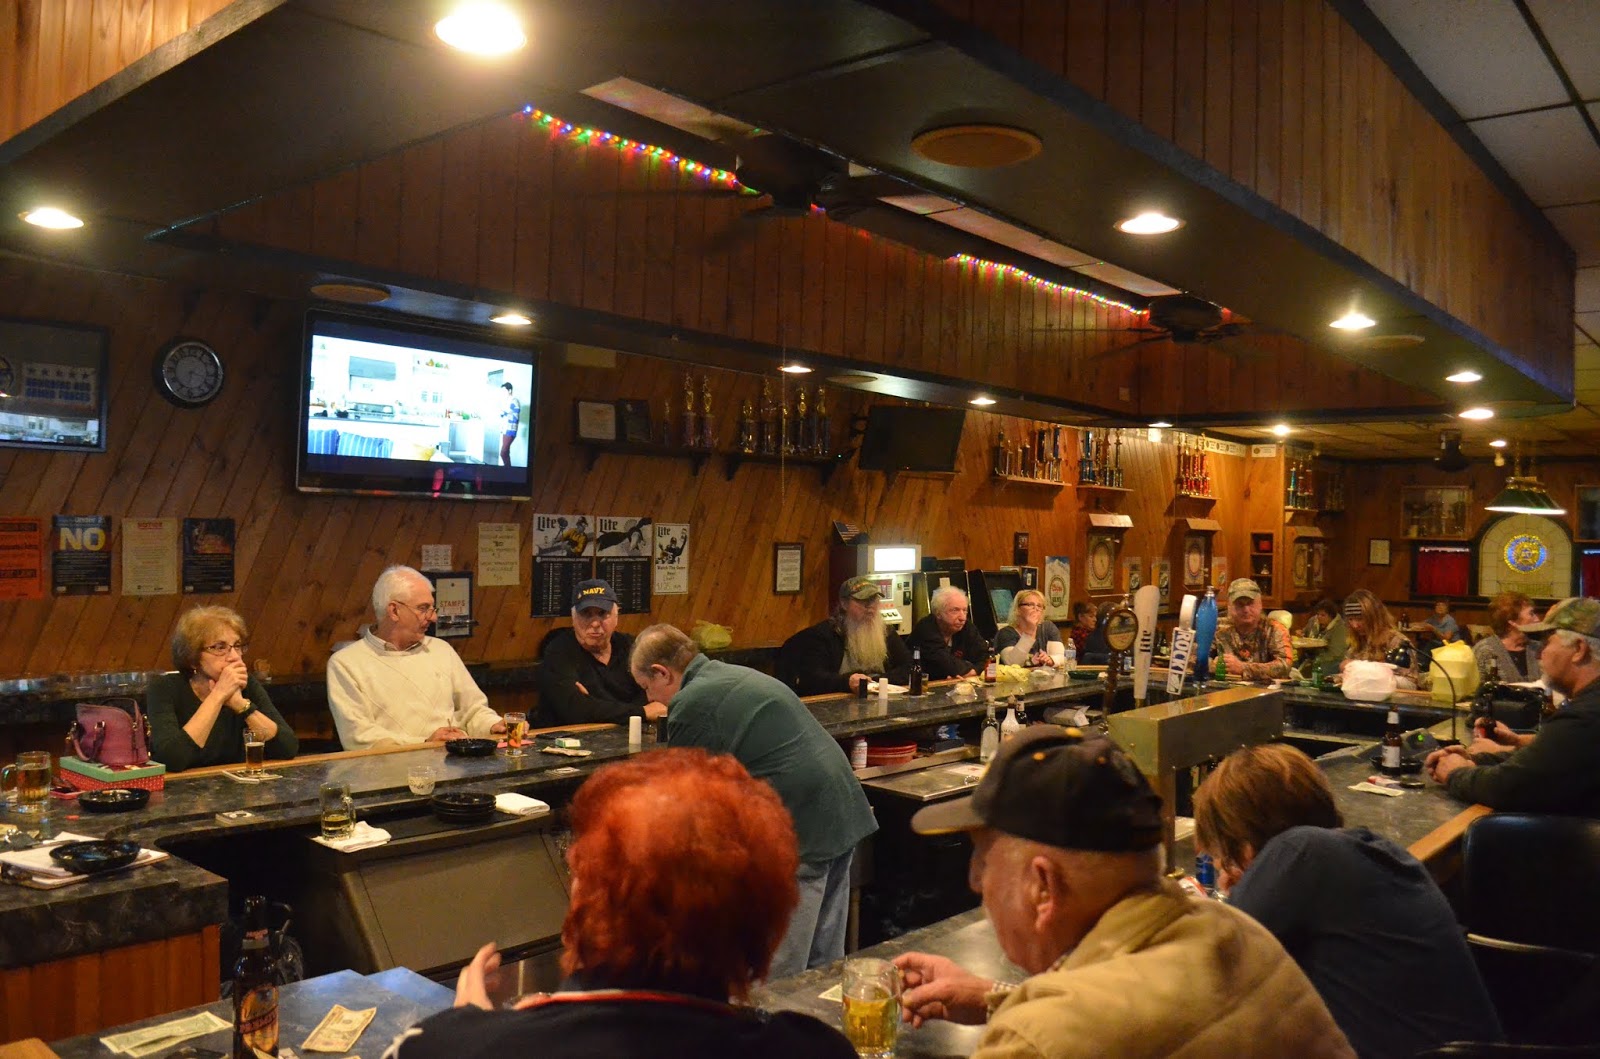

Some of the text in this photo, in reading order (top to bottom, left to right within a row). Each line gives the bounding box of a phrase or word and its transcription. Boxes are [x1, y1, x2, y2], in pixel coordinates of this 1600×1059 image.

[537, 516, 556, 531] Lite
[600, 519, 617, 534] Lite
[60, 527, 106, 551] NO
[657, 526, 671, 537] Lite
[583, 587, 605, 595] NAVY
[1172, 632, 1191, 672] ROCK
